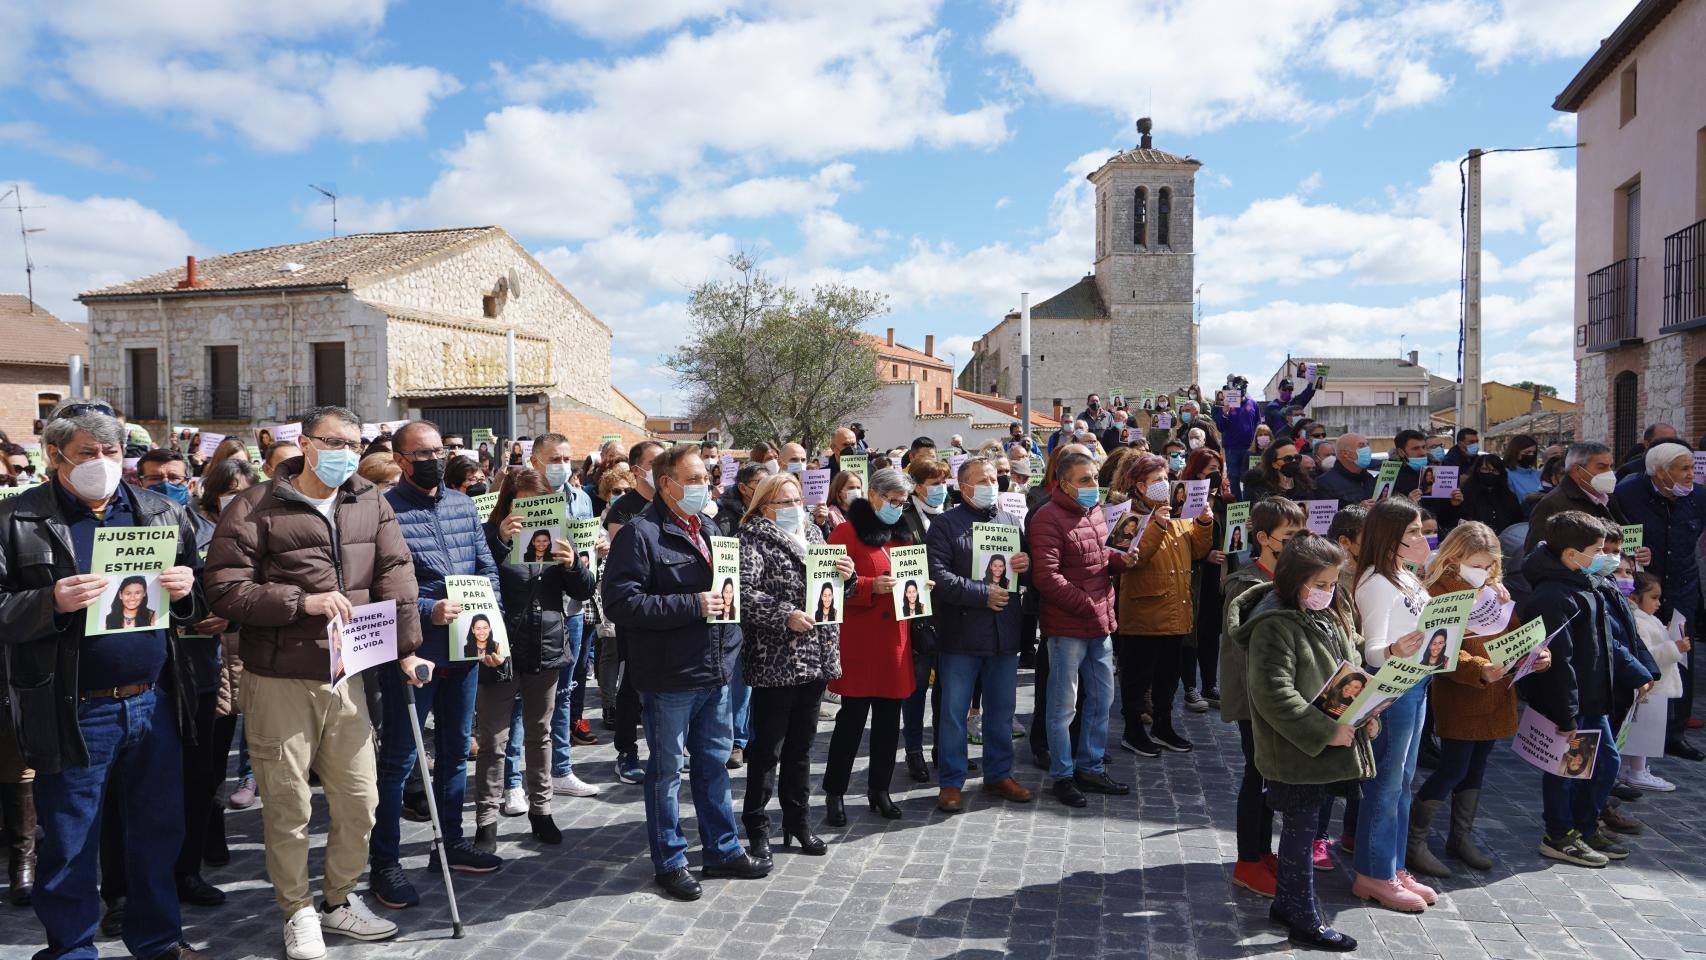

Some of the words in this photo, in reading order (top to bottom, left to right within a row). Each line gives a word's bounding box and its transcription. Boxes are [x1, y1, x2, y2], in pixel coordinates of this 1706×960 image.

[514, 495, 565, 508] #JUSTICIA
[527, 508, 553, 517] PARA
[521, 518, 559, 528] ESTHER
[567, 520, 600, 529] JUSTICIA
[974, 525, 1018, 534] #JUSTICIA
[97, 530, 175, 542] #JUSTICIA
[573, 531, 592, 539] PARA
[116, 546, 155, 556] PARA
[808, 548, 846, 556] #JUSTICIA
[891, 547, 926, 557] #JUSTICIA
[980, 544, 1014, 553] ESTHER
[105, 561, 163, 573] ESTHER
[899, 559, 918, 567] PARA
[718, 565, 737, 573] ESTHER
[896, 569, 923, 578] ESTHER
[813, 571, 840, 579] ESTHER
[1426, 592, 1475, 607] #JUSTICIA
[1432, 605, 1458, 615] PARA
[1424, 616, 1461, 629] ESTHER
[342, 619, 395, 637] TRASPINEDO
[354, 634, 367, 642] NO
[369, 630, 380, 638] TE
[1487, 620, 1542, 652] #JUSTICIA
[352, 639, 384, 652] OLVIDA
[1505, 635, 1532, 654] PARA
[1529, 733, 1538, 742] TE
[1530, 725, 1554, 744] OLVIDA
[1517, 732, 1558, 761] TRASPINEDO
[1539, 741, 1549, 749] NO
